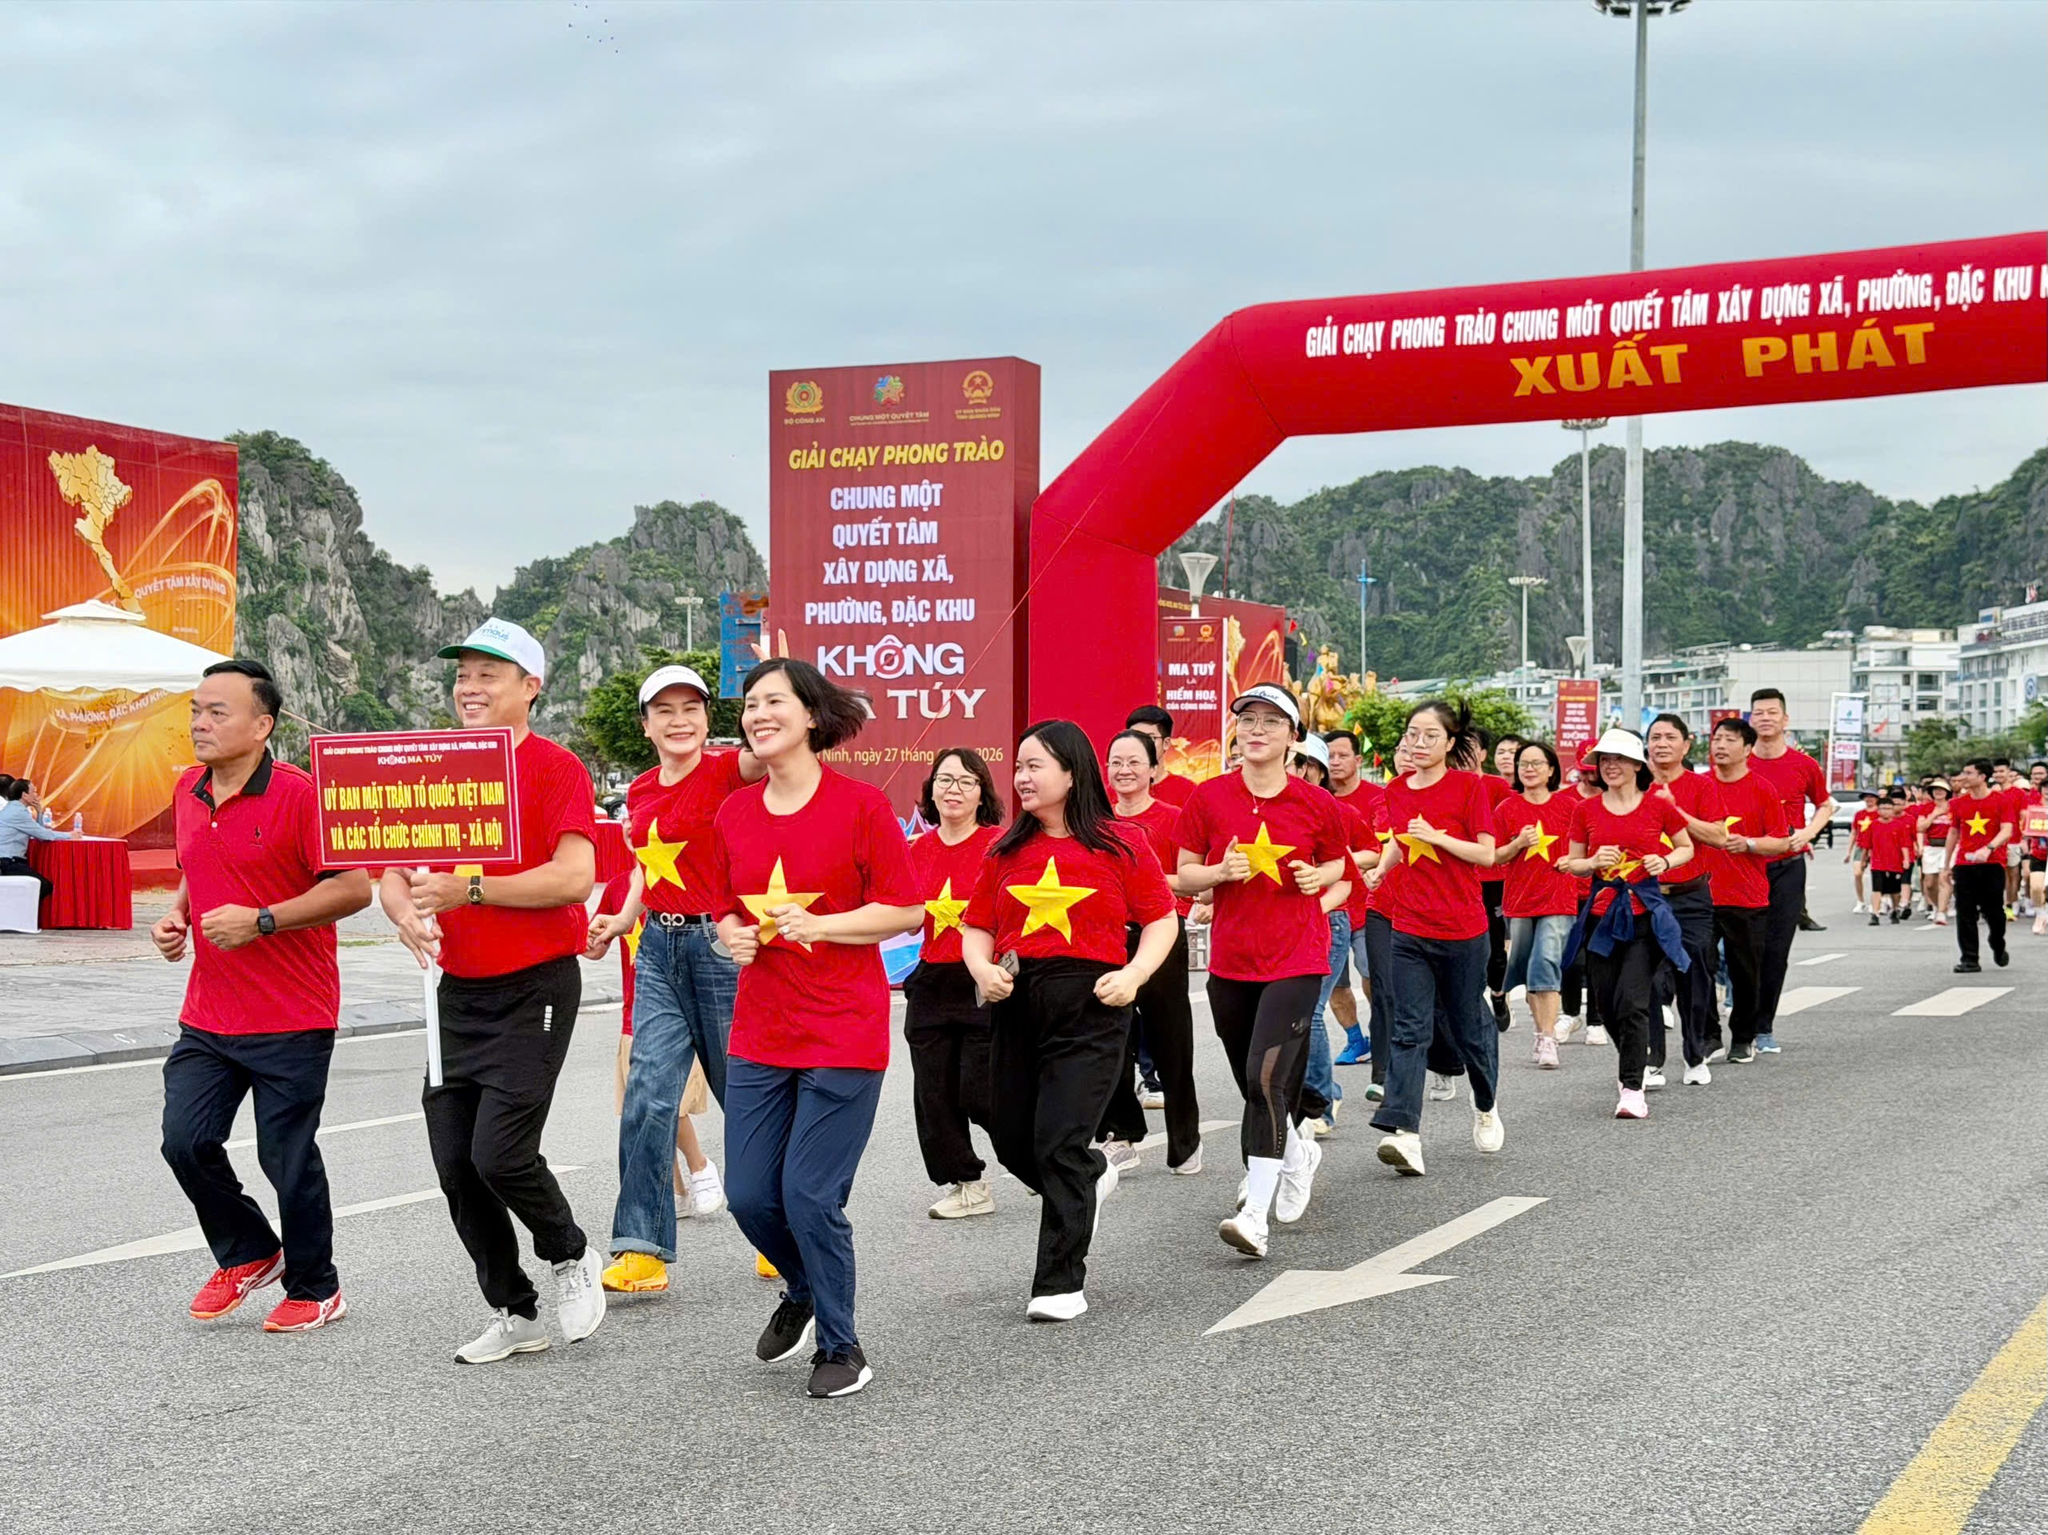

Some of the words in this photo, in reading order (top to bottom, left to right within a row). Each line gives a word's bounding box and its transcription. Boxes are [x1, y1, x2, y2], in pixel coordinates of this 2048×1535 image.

[1306, 315, 1338, 358] GIẢI
[1343, 321, 1386, 360] CHẠY
[1390, 316, 1446, 350] PHONG
[1502, 308, 1559, 344] CHUNG
[1610, 288, 1664, 338] QUYẾT
[1671, 288, 1710, 328] TÂM
[1716, 283, 1753, 324] XÂY
[1760, 282, 1811, 326] DỰNG
[1817, 275, 1851, 318] XÃ,
[1945, 263, 1985, 312] ĐẶC
[1993, 265, 2034, 302] KHU
[1509, 332, 1688, 397] XUẤT
[1741, 318, 1935, 378] PHÁT
[788, 441, 826, 470] GIẢI
[829, 445, 880, 472] CHẠY
[882, 443, 949, 465] PHONG
[953, 435, 1005, 462] TRÀO
[830, 484, 896, 510] CHUNG
[900, 479, 943, 512] MỘT
[832, 516, 892, 549] QUYẾT
[896, 517, 938, 545] TÂM
[823, 557, 860, 584] XÂY
[864, 558, 917, 587] DỰNG
[922, 554, 954, 584] XÃ,
[805, 596, 888, 626] PHƯỜNG,
[892, 596, 931, 627] ĐẶC
[936, 598, 975, 621] KHU
[817, 634, 965, 679] KHÔNG
[1168, 663, 1189, 676] MA
[887, 682, 986, 719] TÚY
[407, 756, 422, 764] MA
[822, 749, 852, 763] Ninh,
[854, 747, 882, 765] ngày
[884, 748, 898, 761] 27
[900, 747, 934, 765] tháng
[339, 786, 360, 810] BAN
[362, 781, 383, 814] MẶT
[385, 780, 412, 814] TRẬN
[428, 775, 455, 810] QUỐC
[456, 777, 478, 811] VIỆT
[480, 781, 505, 806] NAM
[330, 822, 345, 850] VÀ
[346, 821, 367, 850] CÁC
[383, 820, 410, 849] CHỨC
[411, 819, 443, 848] CHÍNH
[443, 823, 461, 852] TRỊ
[468, 818, 484, 846] XÃ
[484, 817, 503, 851] HỘI
